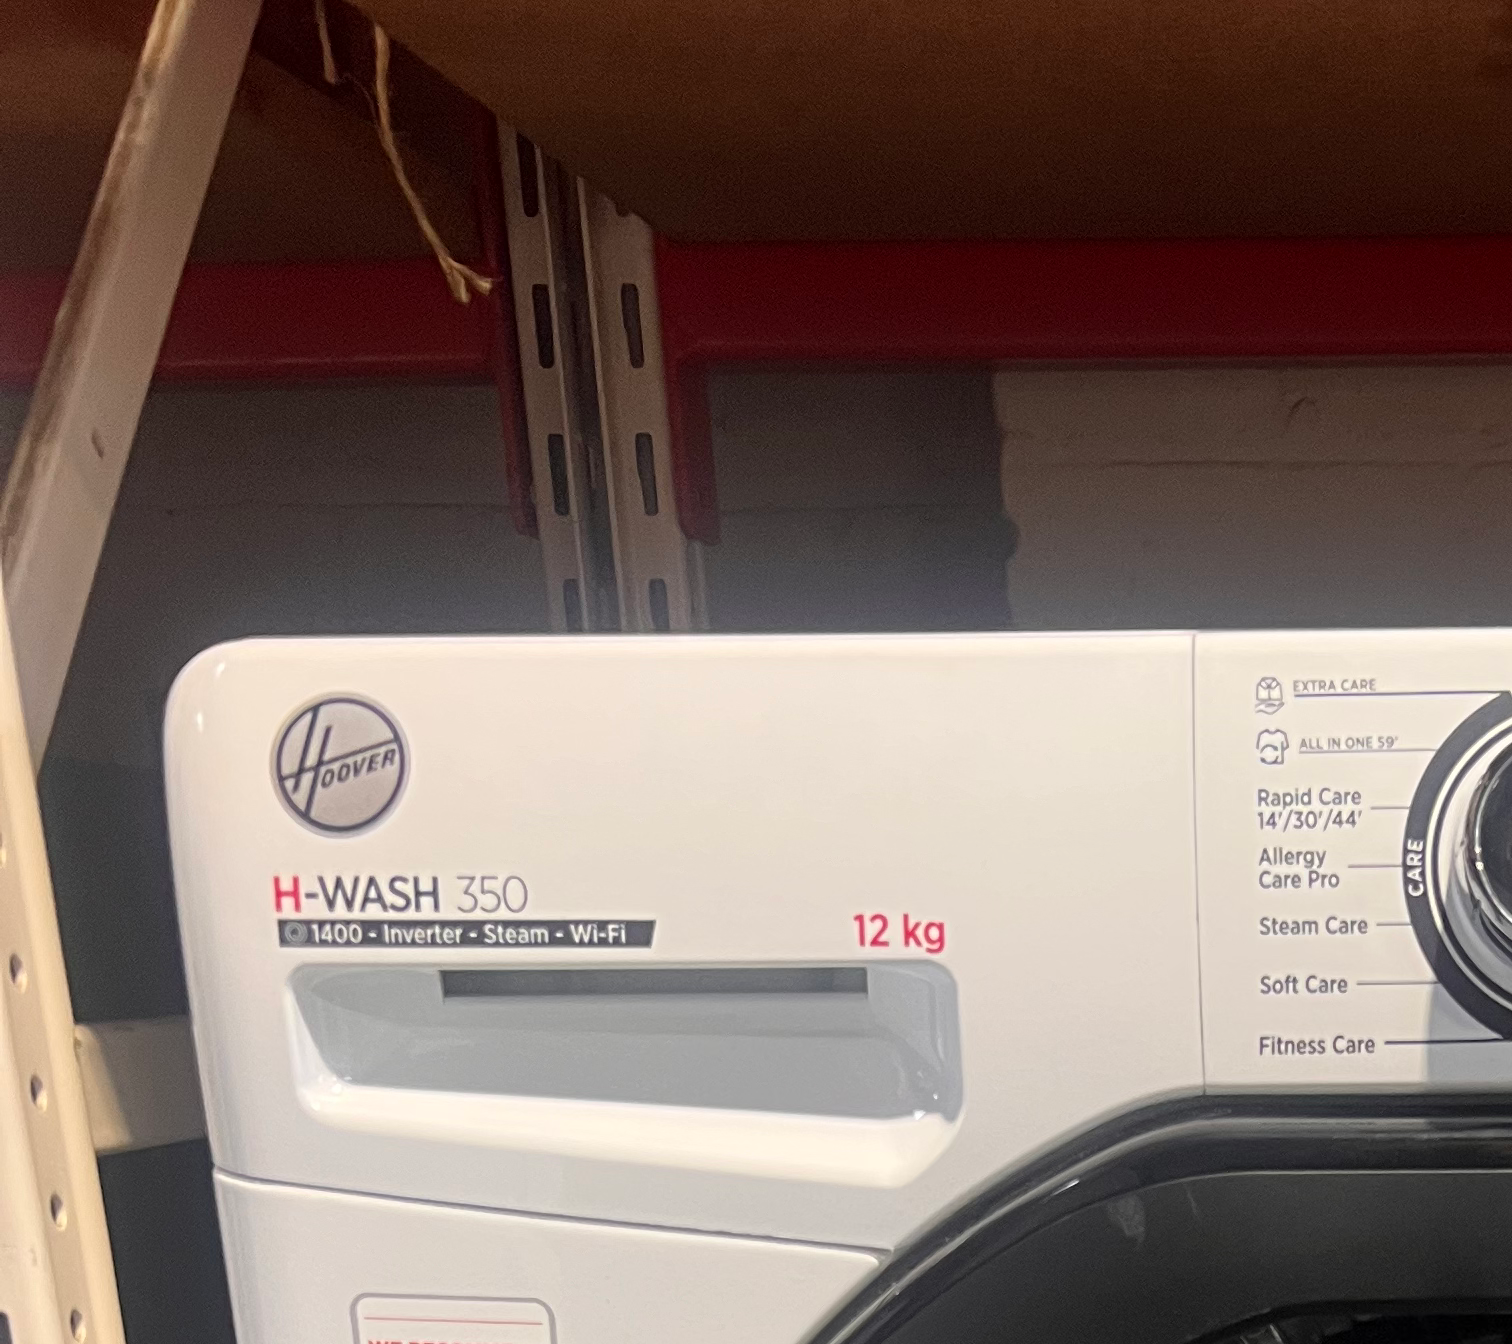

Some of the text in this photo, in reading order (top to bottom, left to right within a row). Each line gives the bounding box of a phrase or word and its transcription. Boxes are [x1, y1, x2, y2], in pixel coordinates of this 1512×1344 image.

[1293, 679, 1376, 691] EXTRA CARE
[1300, 738, 1323, 750] ALL
[1328, 738, 1340, 749] IN
[1345, 737, 1373, 748] ONE
[277, 705, 398, 815] HOOVER
[1258, 788, 1362, 810] Rapid Care
[1259, 847, 1327, 868] Allergy
[1407, 839, 1424, 896] CARE
[1259, 870, 1340, 889] Care Pro
[273, 875, 528, 913] H-WASH 350
[312, 923, 362, 943] 1400
[384, 924, 462, 944] Inverter
[483, 924, 549, 944] Steam
[570, 924, 626, 944] Wi-Fi
[854, 913, 944, 953] 12 kg
[1259, 916, 1368, 935] Steam Care
[1260, 975, 1348, 994] Soft Care
[1259, 1036, 1375, 1056] Fitness Care
